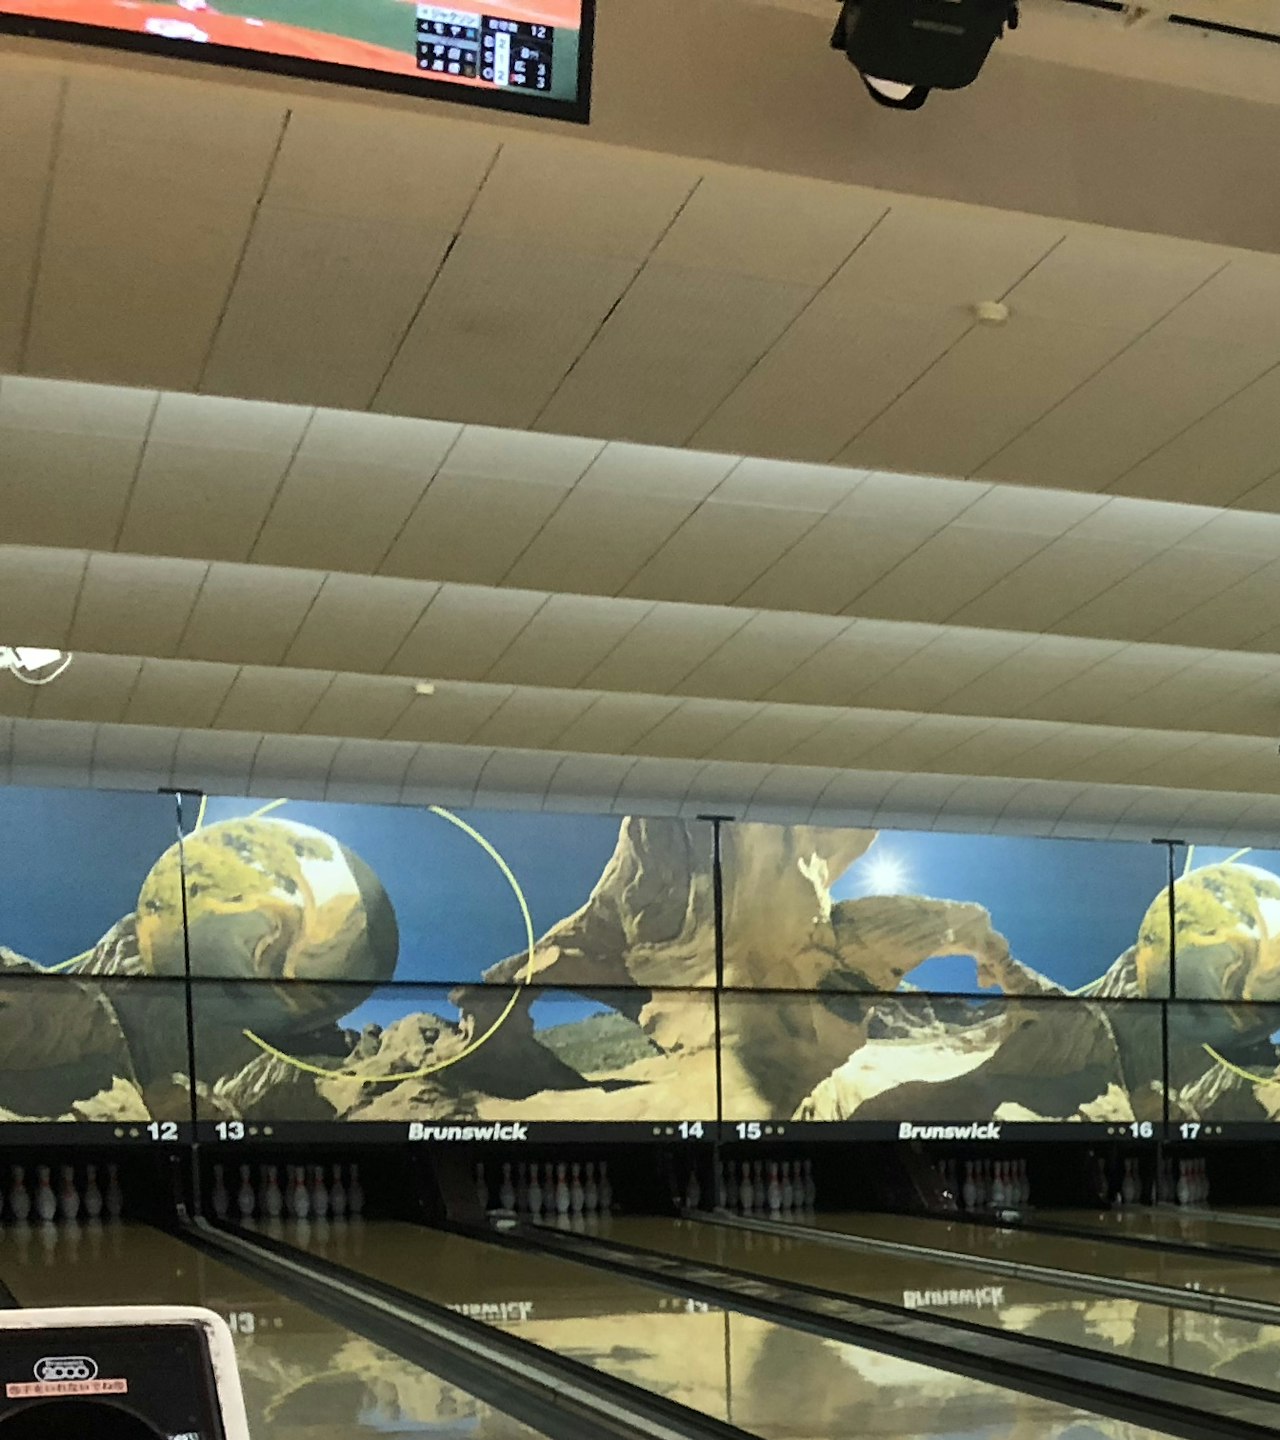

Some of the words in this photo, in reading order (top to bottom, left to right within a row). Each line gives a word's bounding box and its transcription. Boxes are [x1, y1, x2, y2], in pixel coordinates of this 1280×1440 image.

[147, 1122, 178, 1140] 12
[215, 1122, 244, 1140] 13
[408, 1122, 528, 1142] Brunswick
[678, 1122, 704, 1140] 14
[735, 1122, 762, 1140] 15
[898, 1122, 1001, 1141] Brunswick
[1130, 1122, 1153, 1139] 16
[1179, 1123, 1201, 1139] 17
